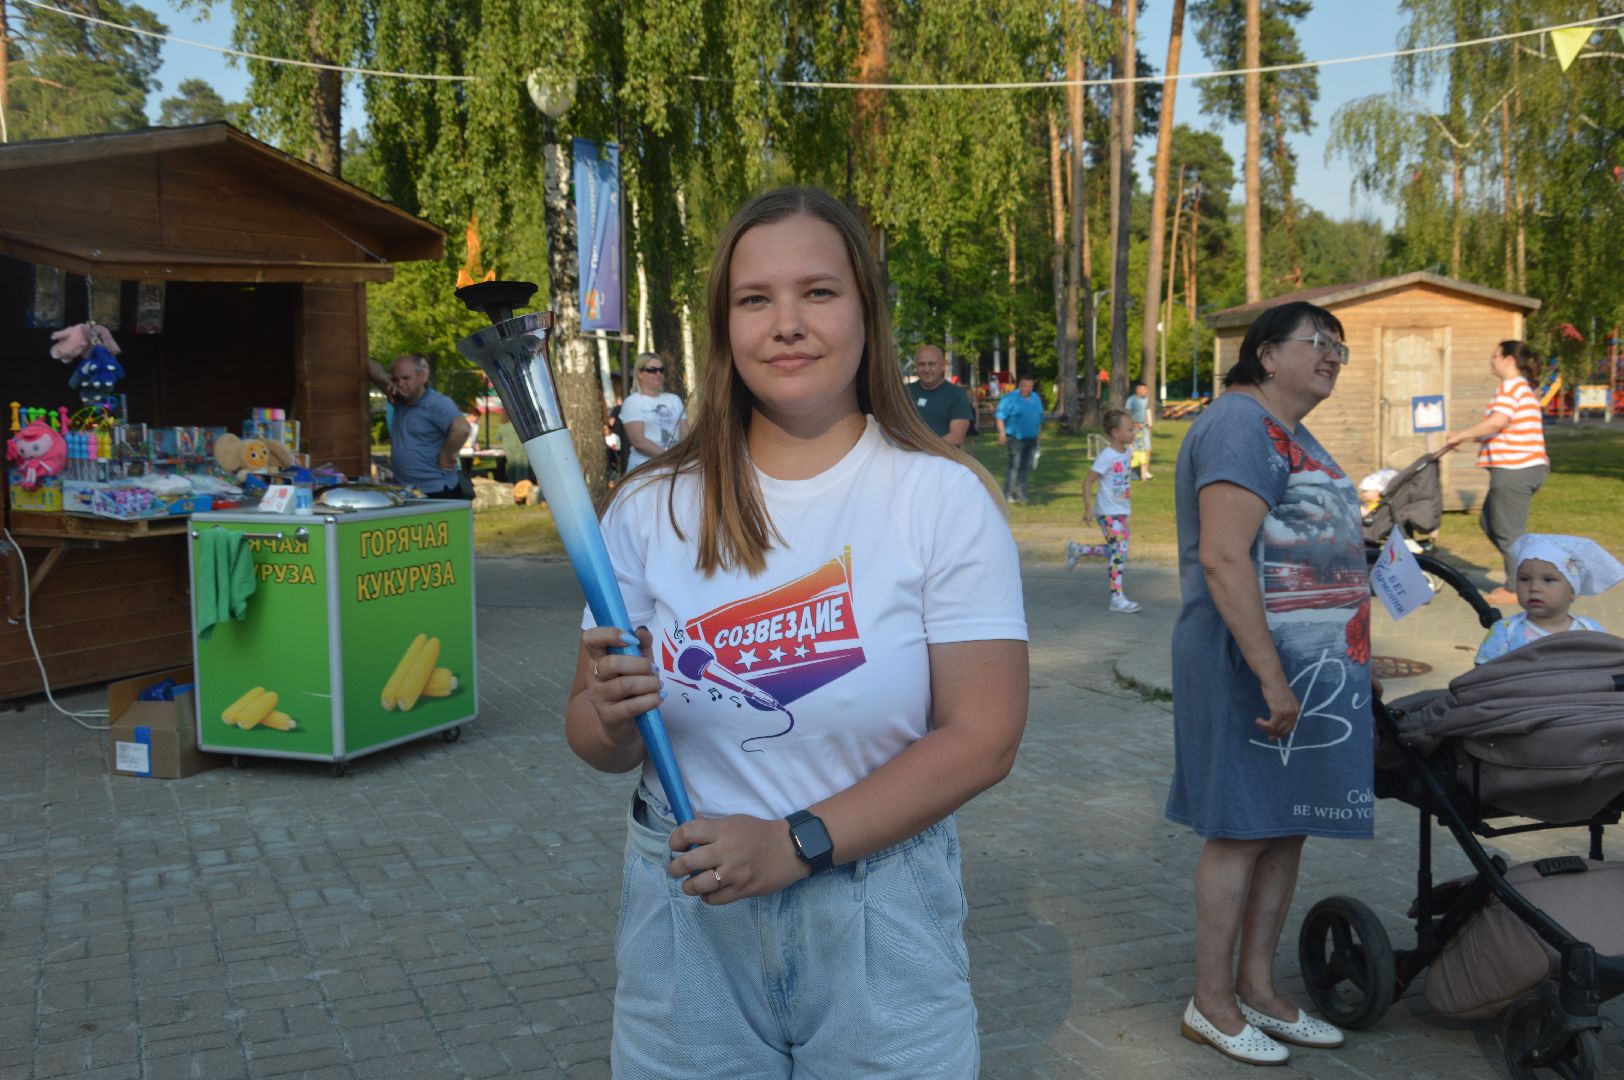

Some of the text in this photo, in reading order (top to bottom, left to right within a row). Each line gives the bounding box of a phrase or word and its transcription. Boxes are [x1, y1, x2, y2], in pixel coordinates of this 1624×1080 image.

[247, 536, 310, 555] ЯЧАЯ
[360, 520, 448, 559] ГОРЯЧАЯ
[254, 563, 316, 585] РУЗА
[356, 559, 456, 602] КУКУРУЗА
[1387, 574, 1407, 596] БЕГ
[713, 596, 845, 649] СОЗВЕЗДИЕ
[1293, 804, 1312, 816] BE
[1314, 806, 1353, 820] WHO
